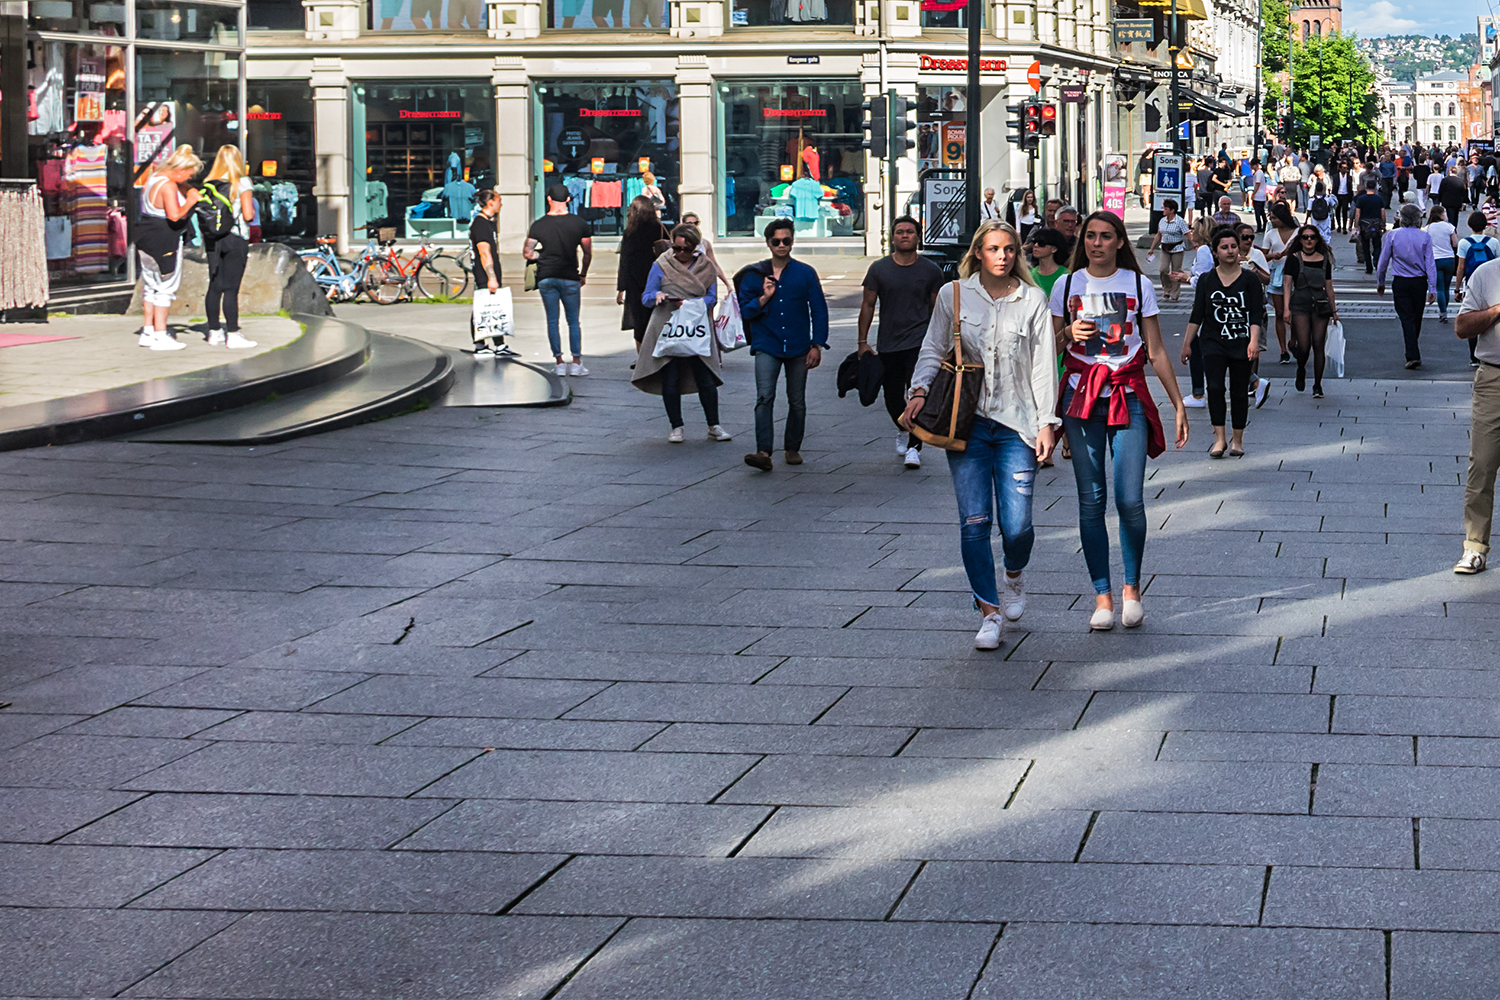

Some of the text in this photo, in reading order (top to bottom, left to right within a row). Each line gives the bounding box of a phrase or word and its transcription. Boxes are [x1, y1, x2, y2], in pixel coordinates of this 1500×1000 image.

[920, 55, 1007, 70] Dressann
[400, 110, 461, 118] Dressmann
[580, 108, 641, 117] Dressmann
[763, 108, 826, 117] Dressmann
[1160, 156, 1178, 165] Sone
[933, 183, 962, 195] Son
